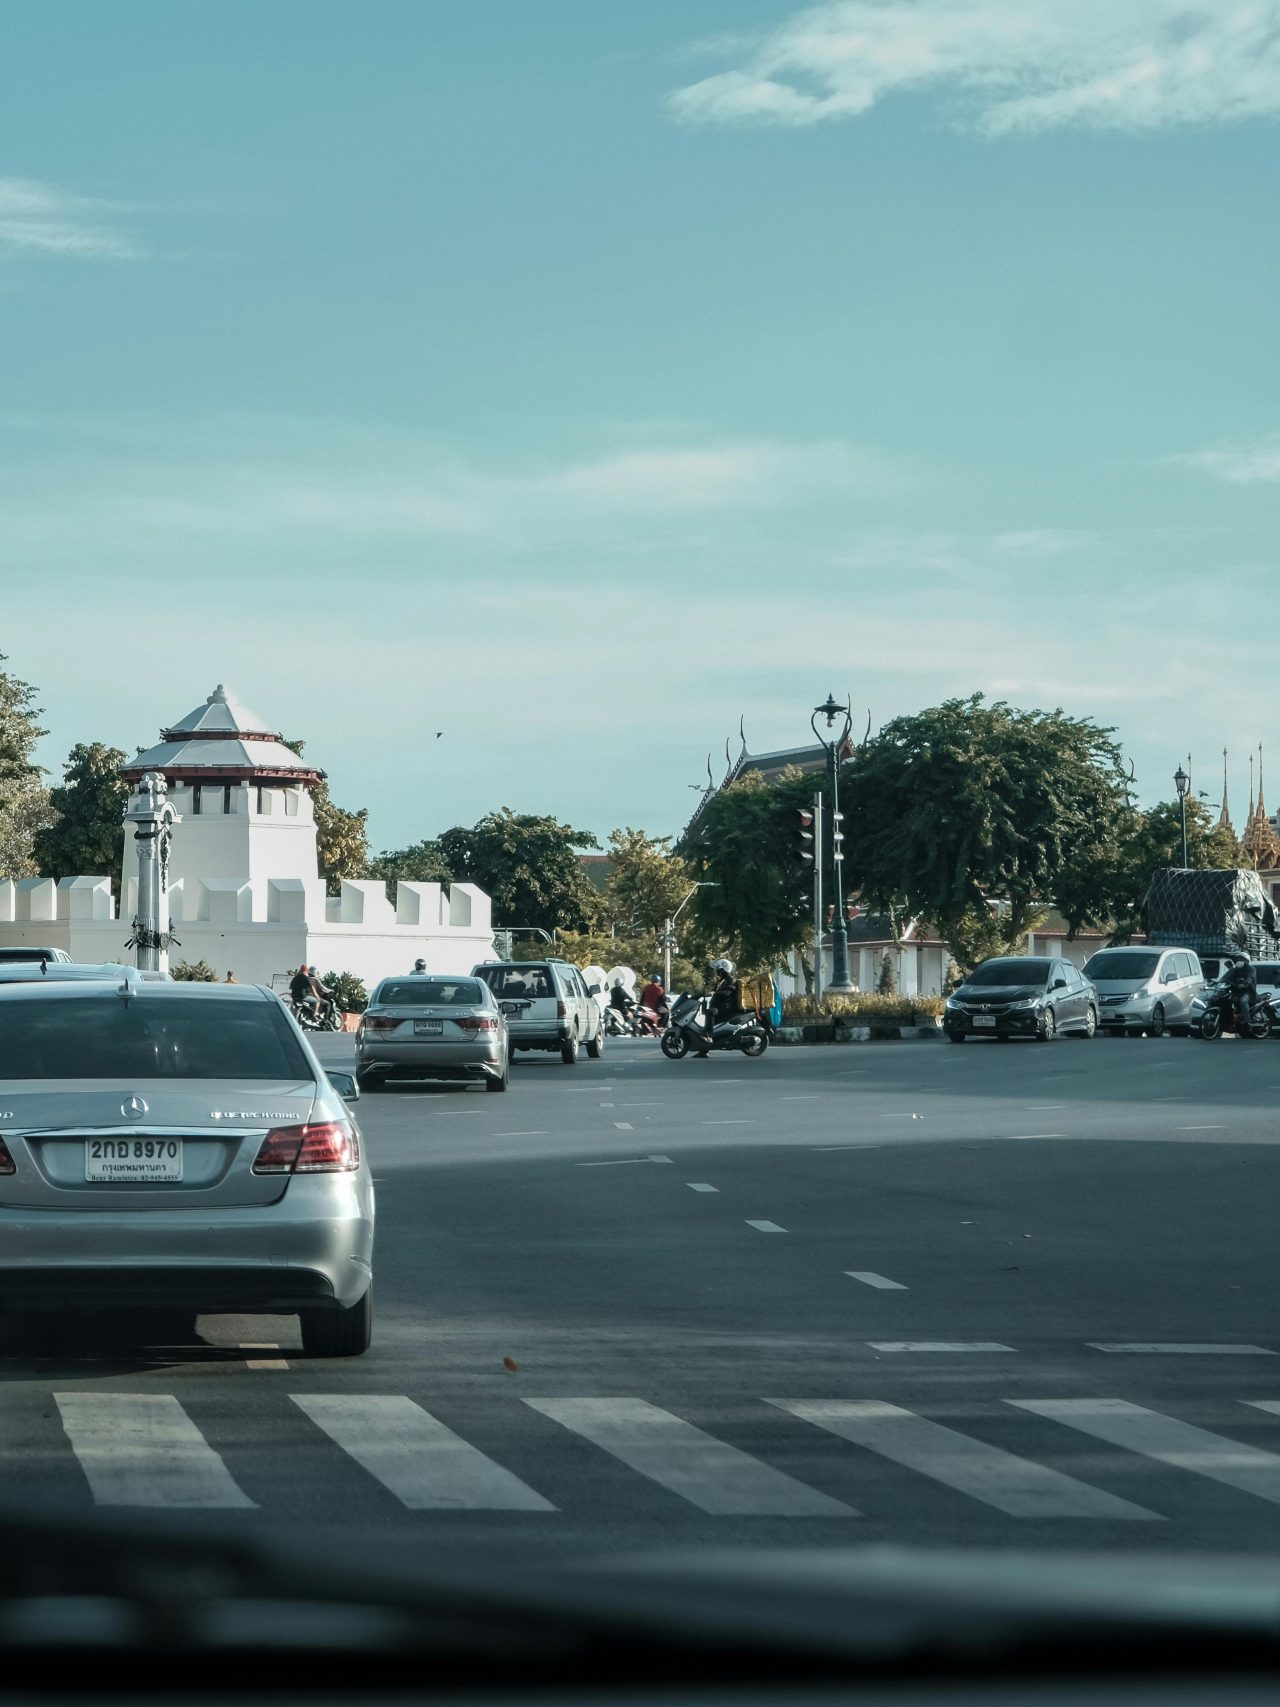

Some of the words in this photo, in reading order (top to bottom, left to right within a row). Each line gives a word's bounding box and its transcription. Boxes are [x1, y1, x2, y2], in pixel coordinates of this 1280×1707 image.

[133, 1141, 177, 1158] 8970
[102, 1164, 166, 1174] กรุงเทพมหานคร
